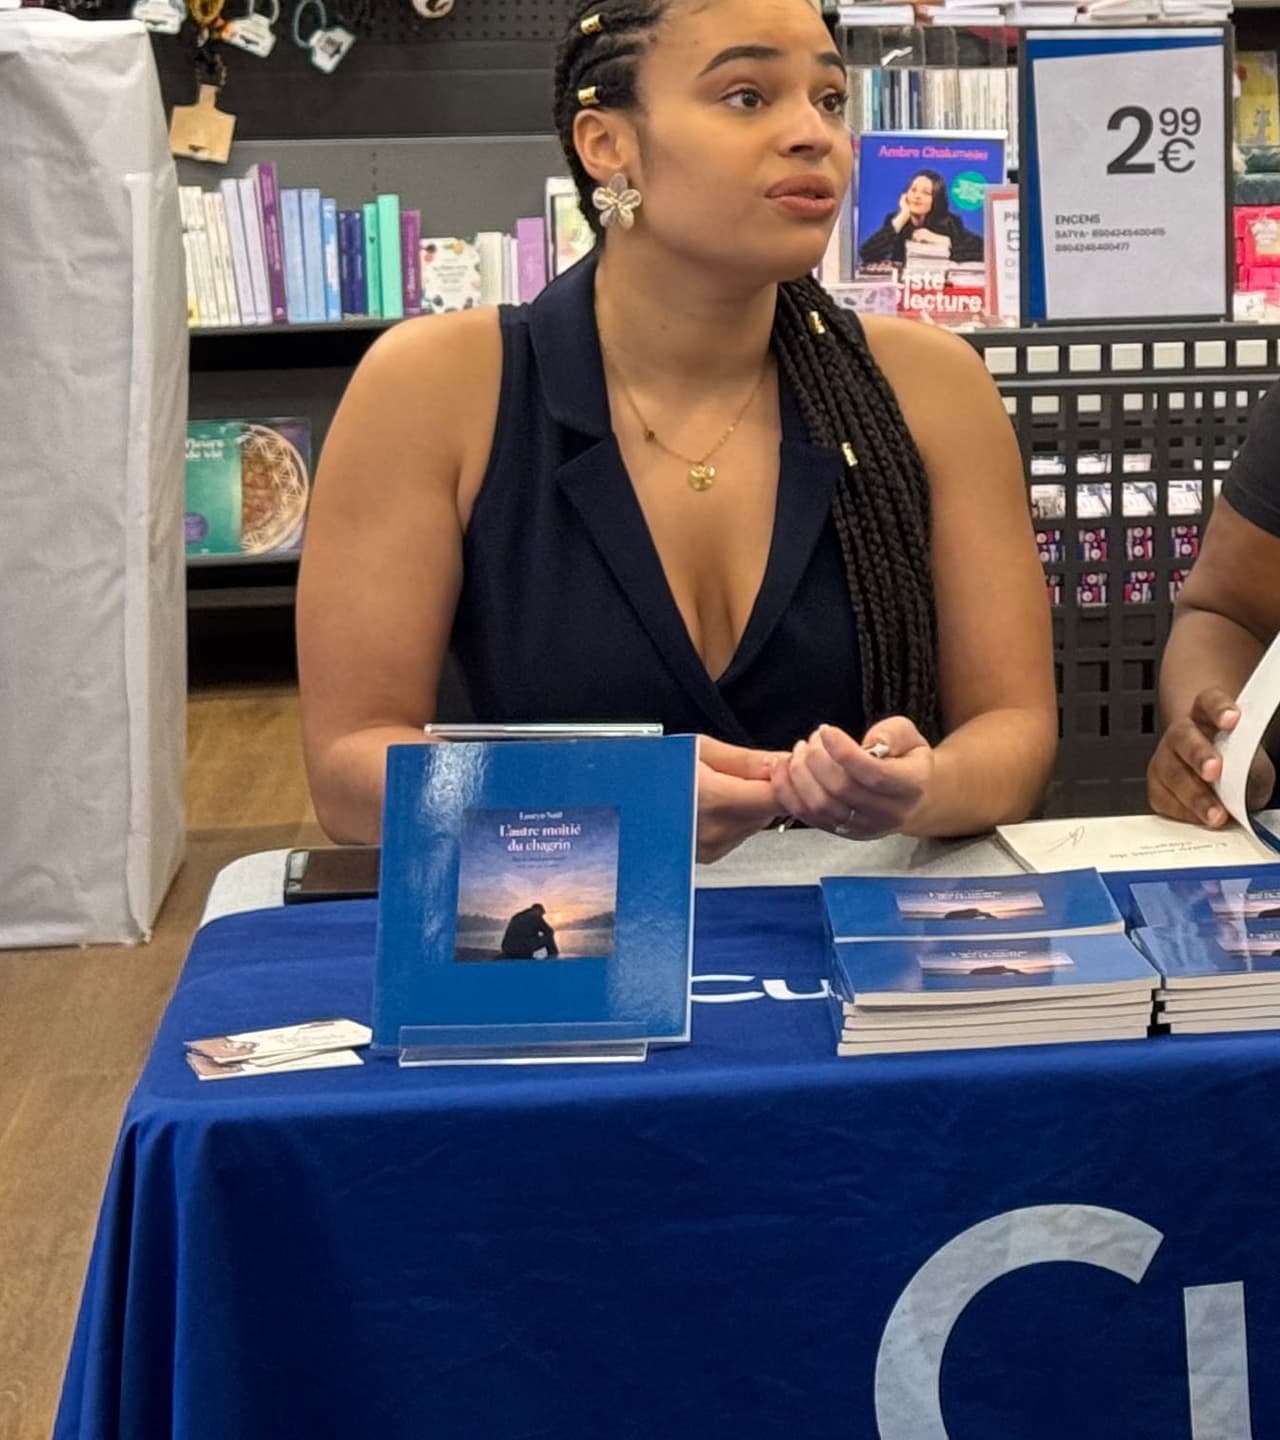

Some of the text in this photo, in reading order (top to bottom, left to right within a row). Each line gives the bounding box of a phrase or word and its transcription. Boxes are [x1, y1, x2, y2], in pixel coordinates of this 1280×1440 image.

[1106, 106, 1155, 175] 2
[1159, 107, 1202, 137] 99
[878, 145, 988, 160] Ambre Chalumeau
[1055, 214, 1101, 225] ENCENS
[903, 292, 984, 313] lecture
[525, 839, 571, 853] chagrin
